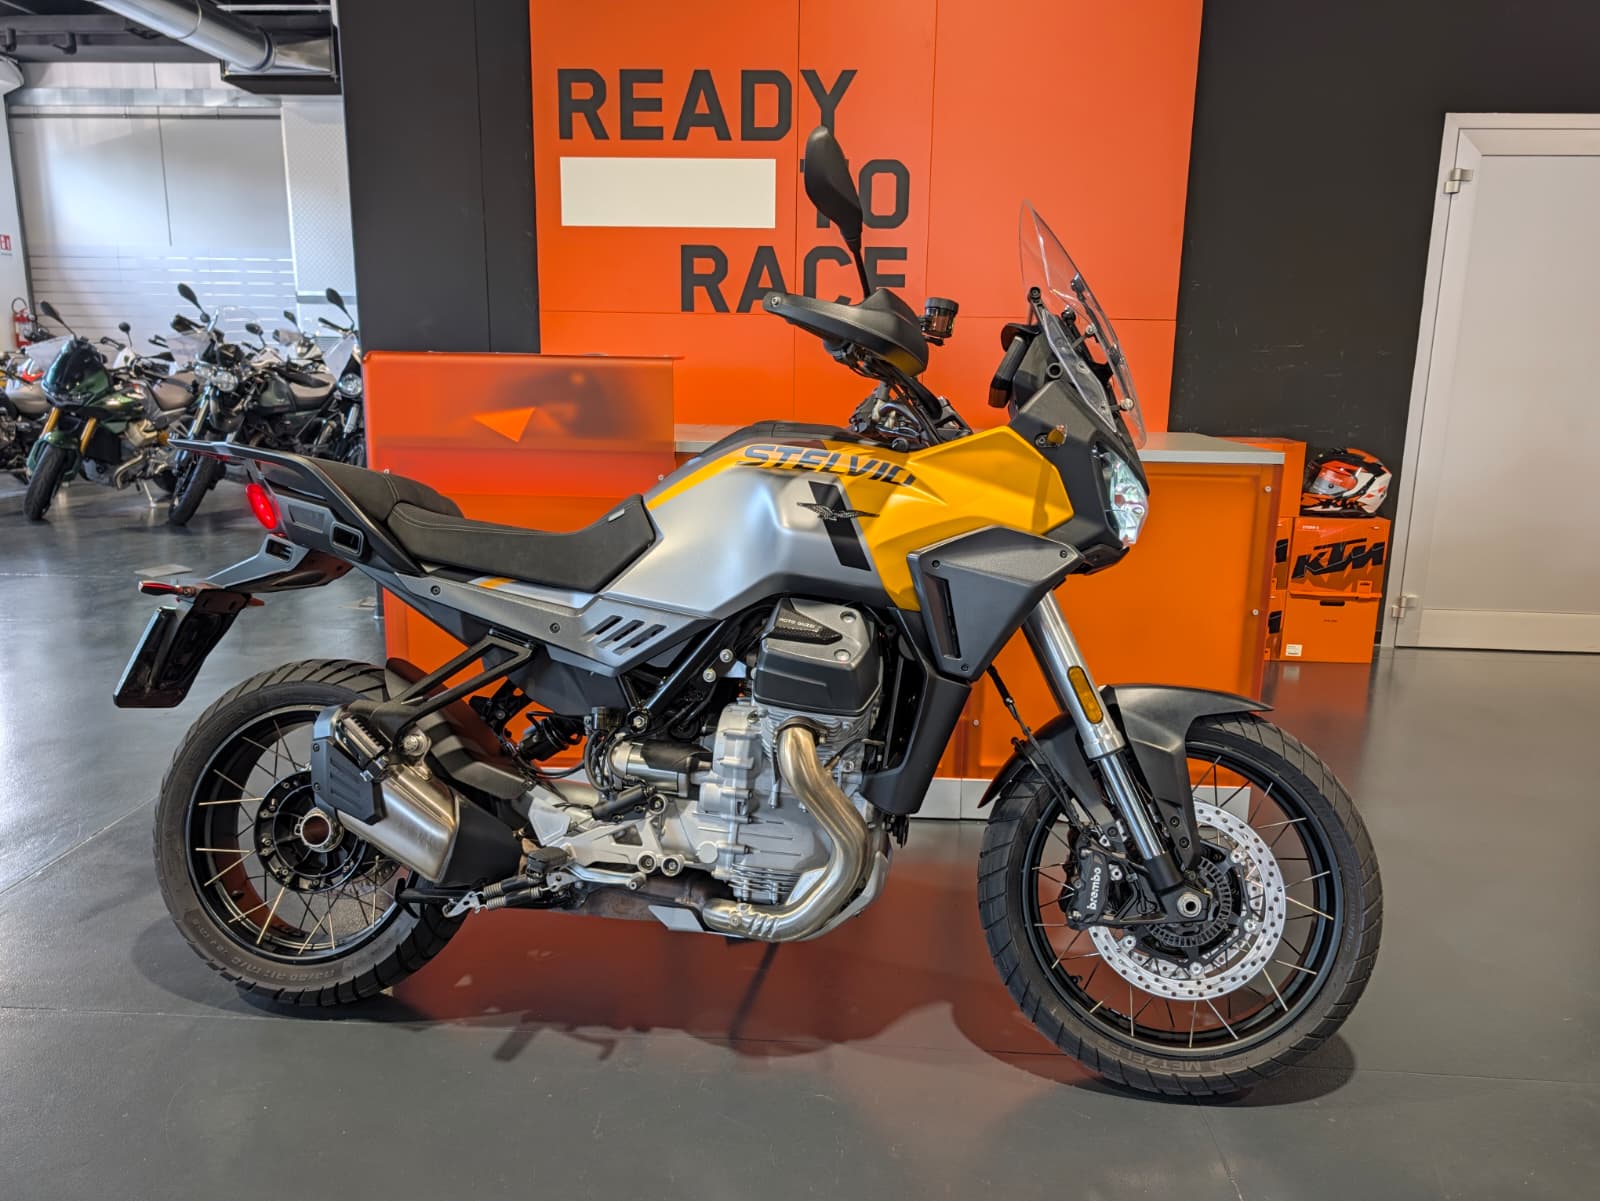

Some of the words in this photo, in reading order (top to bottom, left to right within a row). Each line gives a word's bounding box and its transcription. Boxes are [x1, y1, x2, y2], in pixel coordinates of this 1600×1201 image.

[557, 69, 858, 141] READY
[681, 245, 908, 313] RACE
[738, 445, 917, 485] STELVIO
[1291, 538, 1386, 579] KTM
[1086, 867, 1101, 910] brembo
